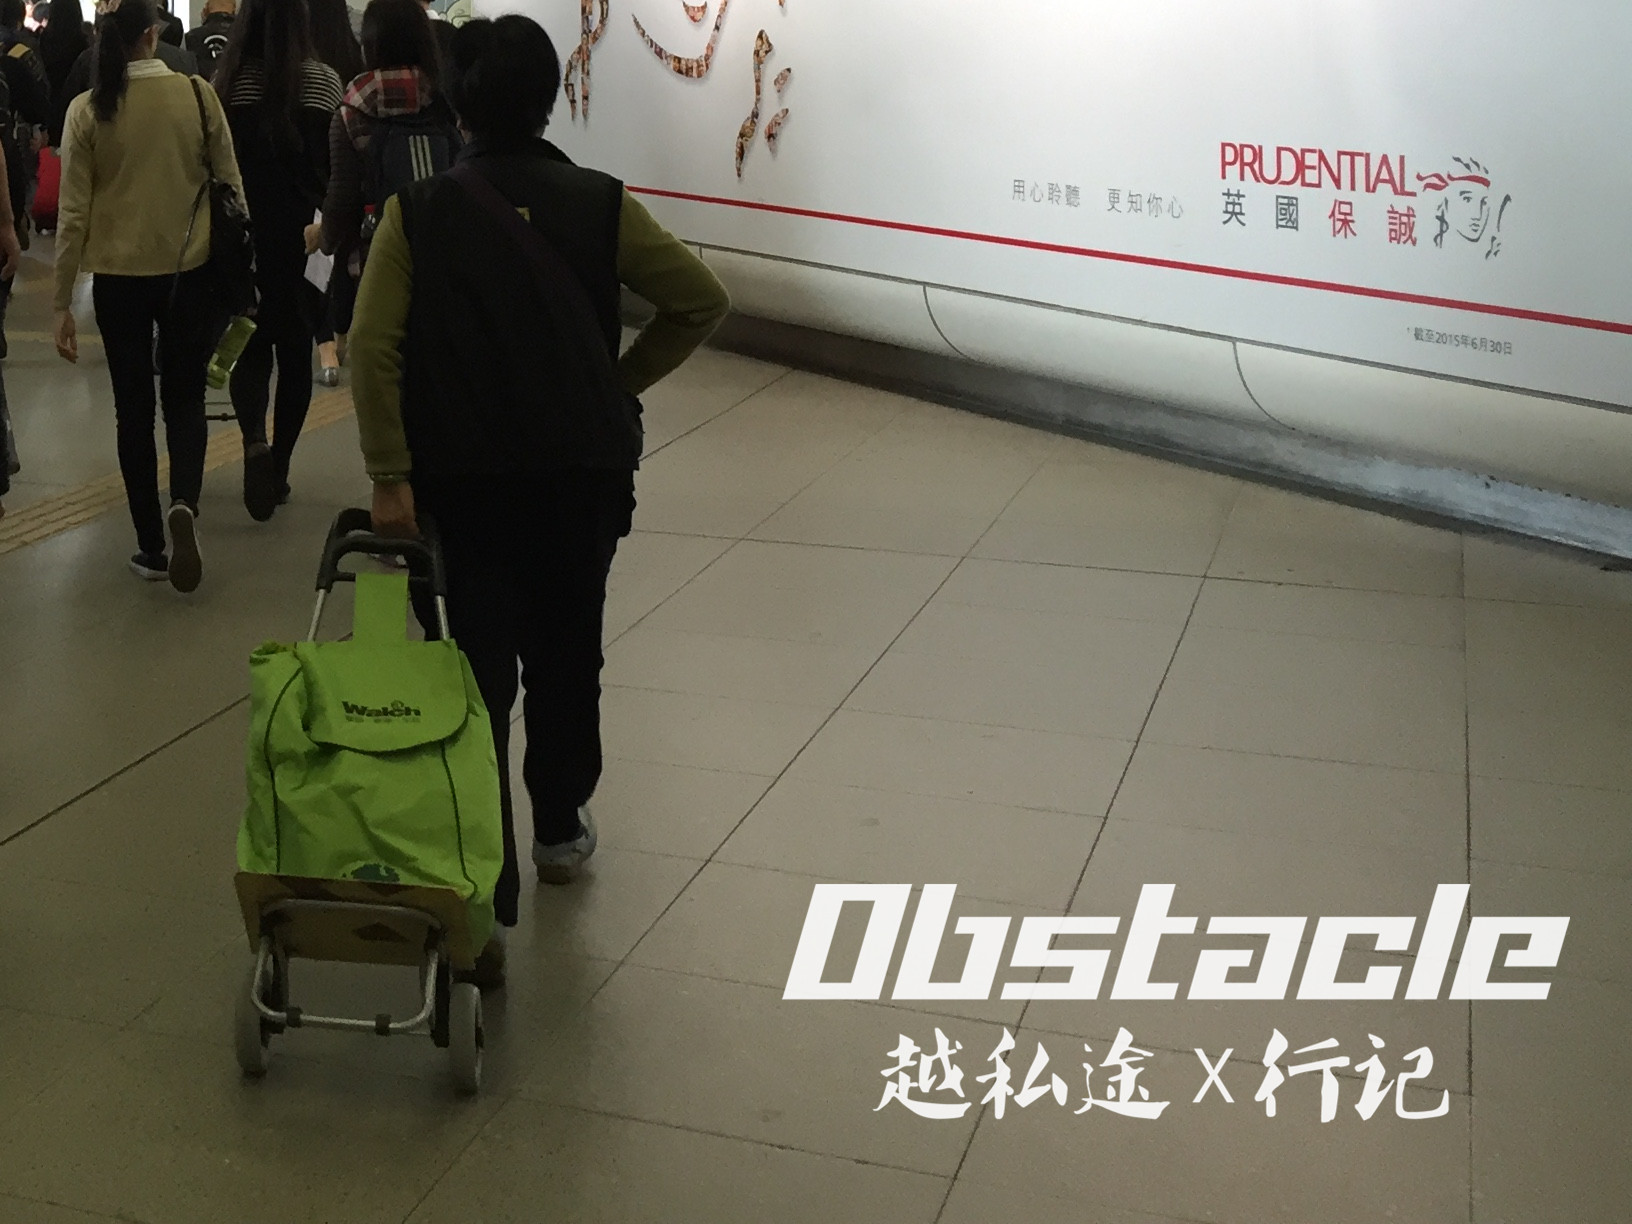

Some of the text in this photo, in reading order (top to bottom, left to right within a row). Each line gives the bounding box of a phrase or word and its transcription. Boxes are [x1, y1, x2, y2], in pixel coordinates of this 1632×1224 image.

[1221, 142, 1417, 197] PRUDENTIAL
[1106, 188, 1184, 219] 更知你心
[1221, 188, 1418, 246] 英國保誠
